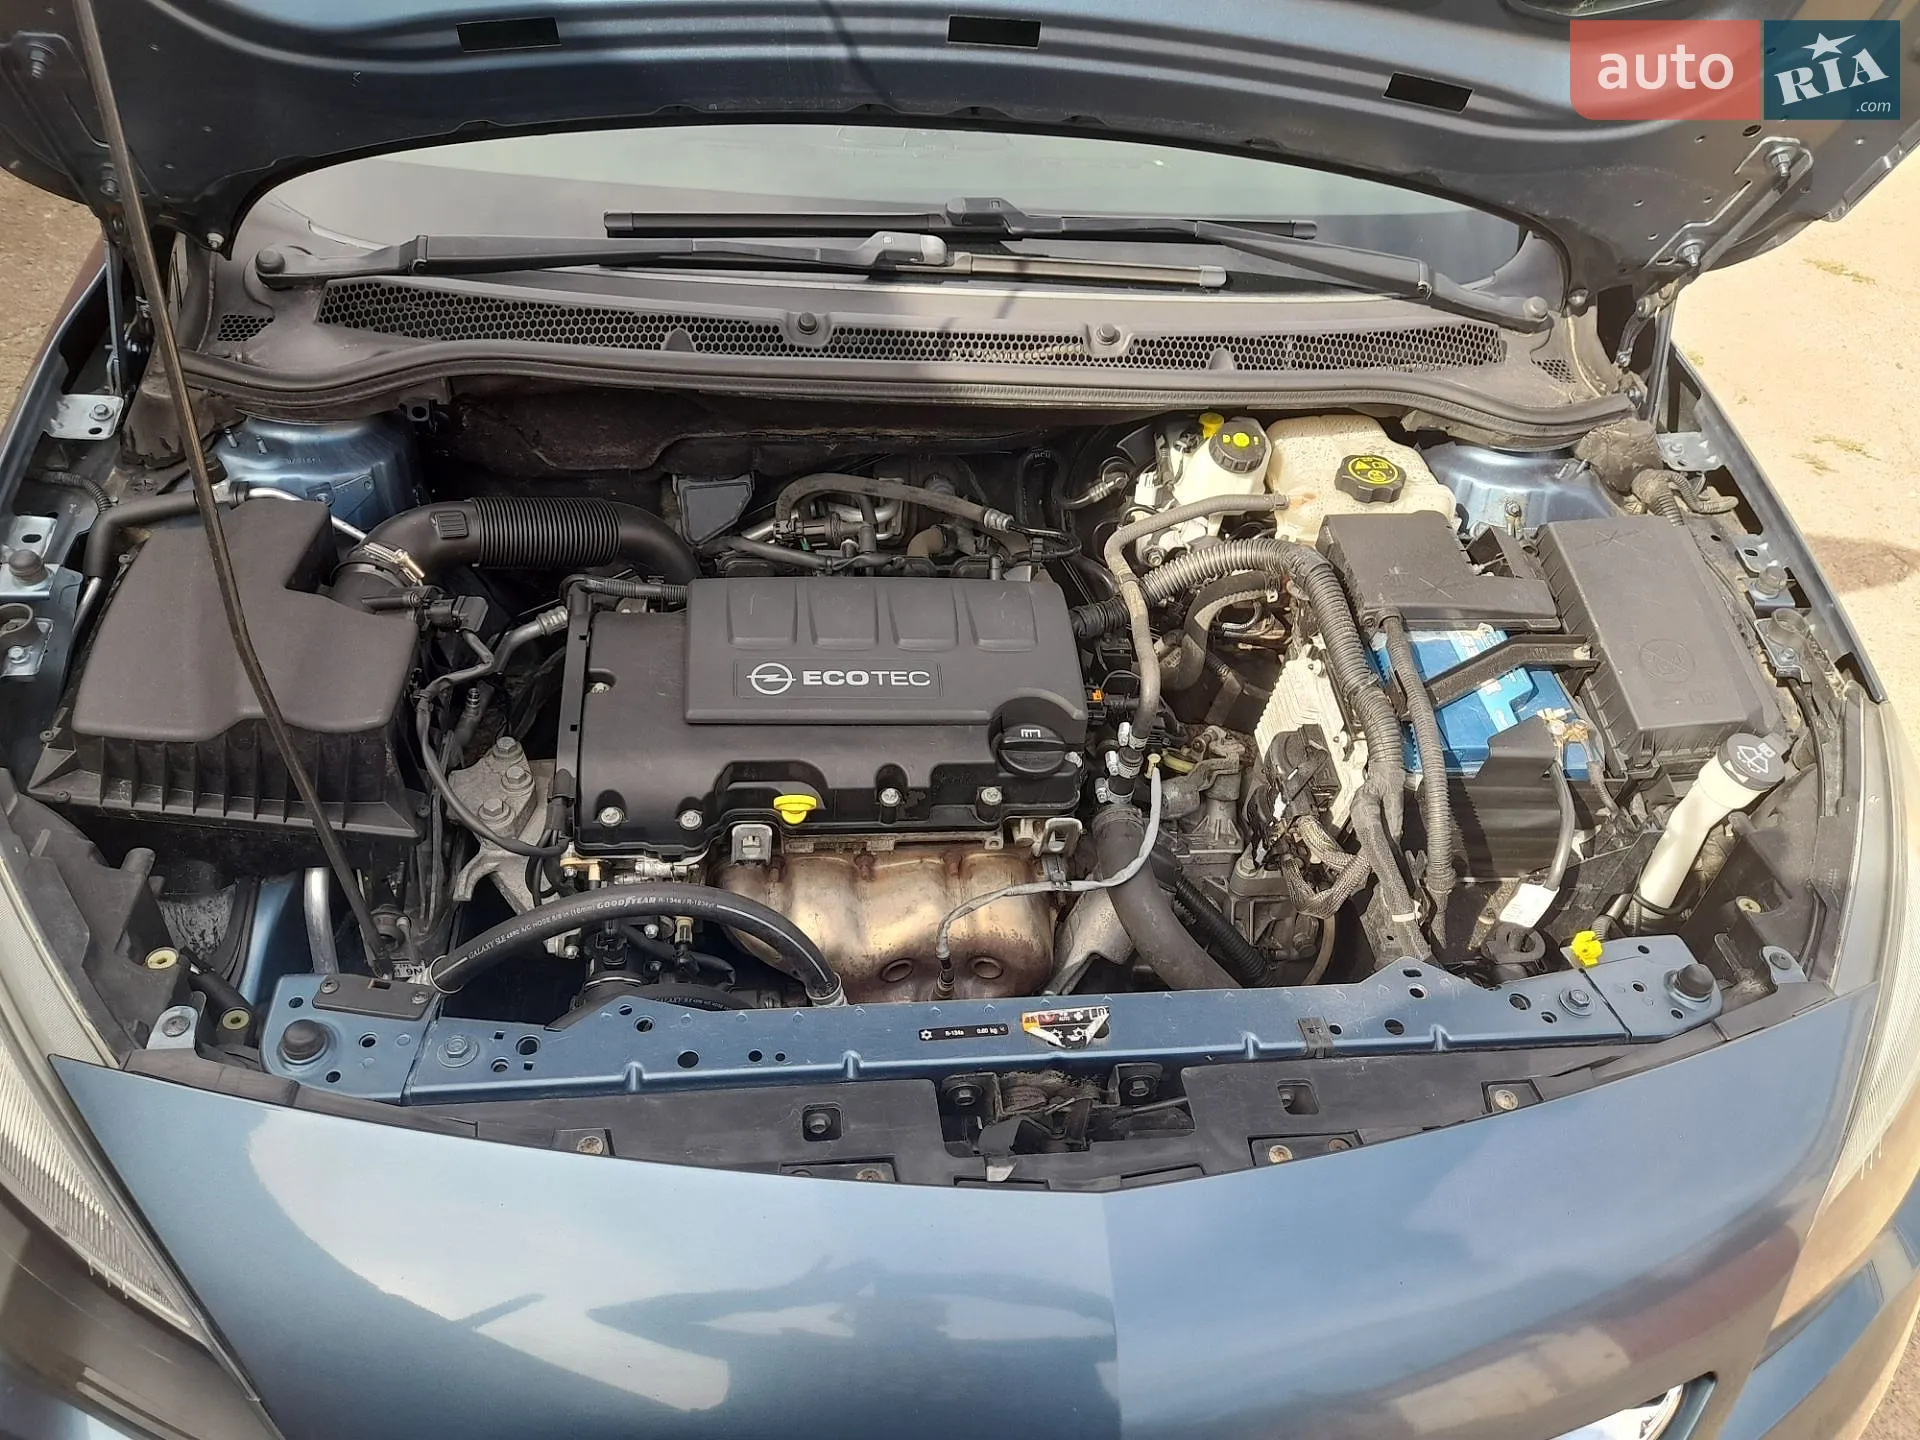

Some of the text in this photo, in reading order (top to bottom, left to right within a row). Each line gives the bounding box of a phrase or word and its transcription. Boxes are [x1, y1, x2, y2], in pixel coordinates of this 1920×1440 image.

[802, 670, 931, 686] ECOTEC
[468, 940, 494, 959] GALAXY
[495, 934, 506, 945] SLE
[597, 896, 656, 909] GOODYEAR
